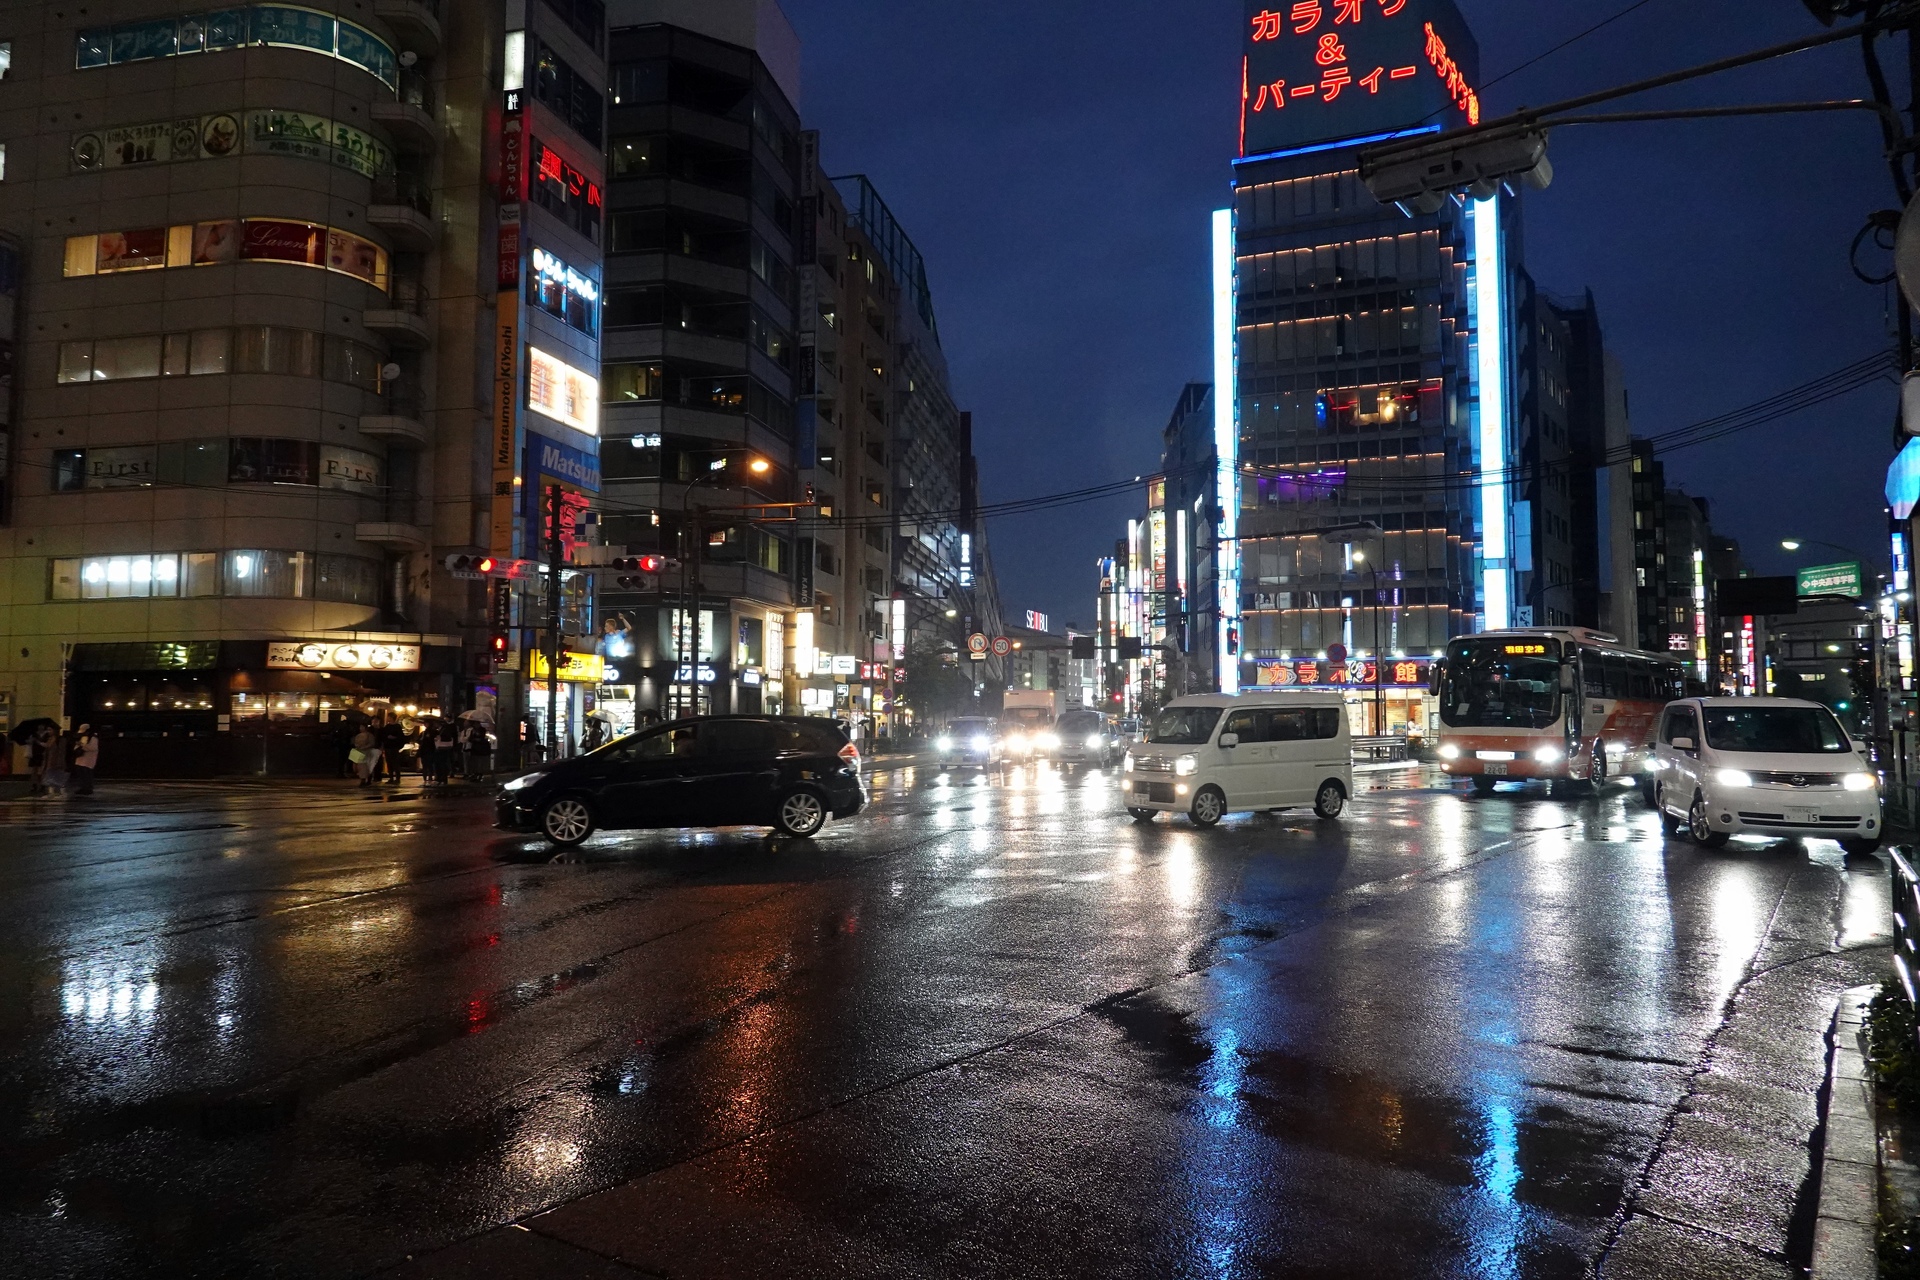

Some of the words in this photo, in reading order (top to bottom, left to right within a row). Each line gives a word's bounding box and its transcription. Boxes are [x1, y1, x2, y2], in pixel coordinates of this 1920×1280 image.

[1315, 33, 1347, 65] &
[1253, 66, 1417, 112] パーティー
[505, 138, 519, 196] とんちゃん
[498, 383, 511, 464] Matsumoto
[93, 459, 152, 477] First
[801, 576, 809, 604] KAMO
[1026, 609, 1048, 633] SEIBU
[995, 641, 1008, 651] 50
[1504, 644, 1545, 655] 羽田空港
[1807, 814, 1818, 823] 15
